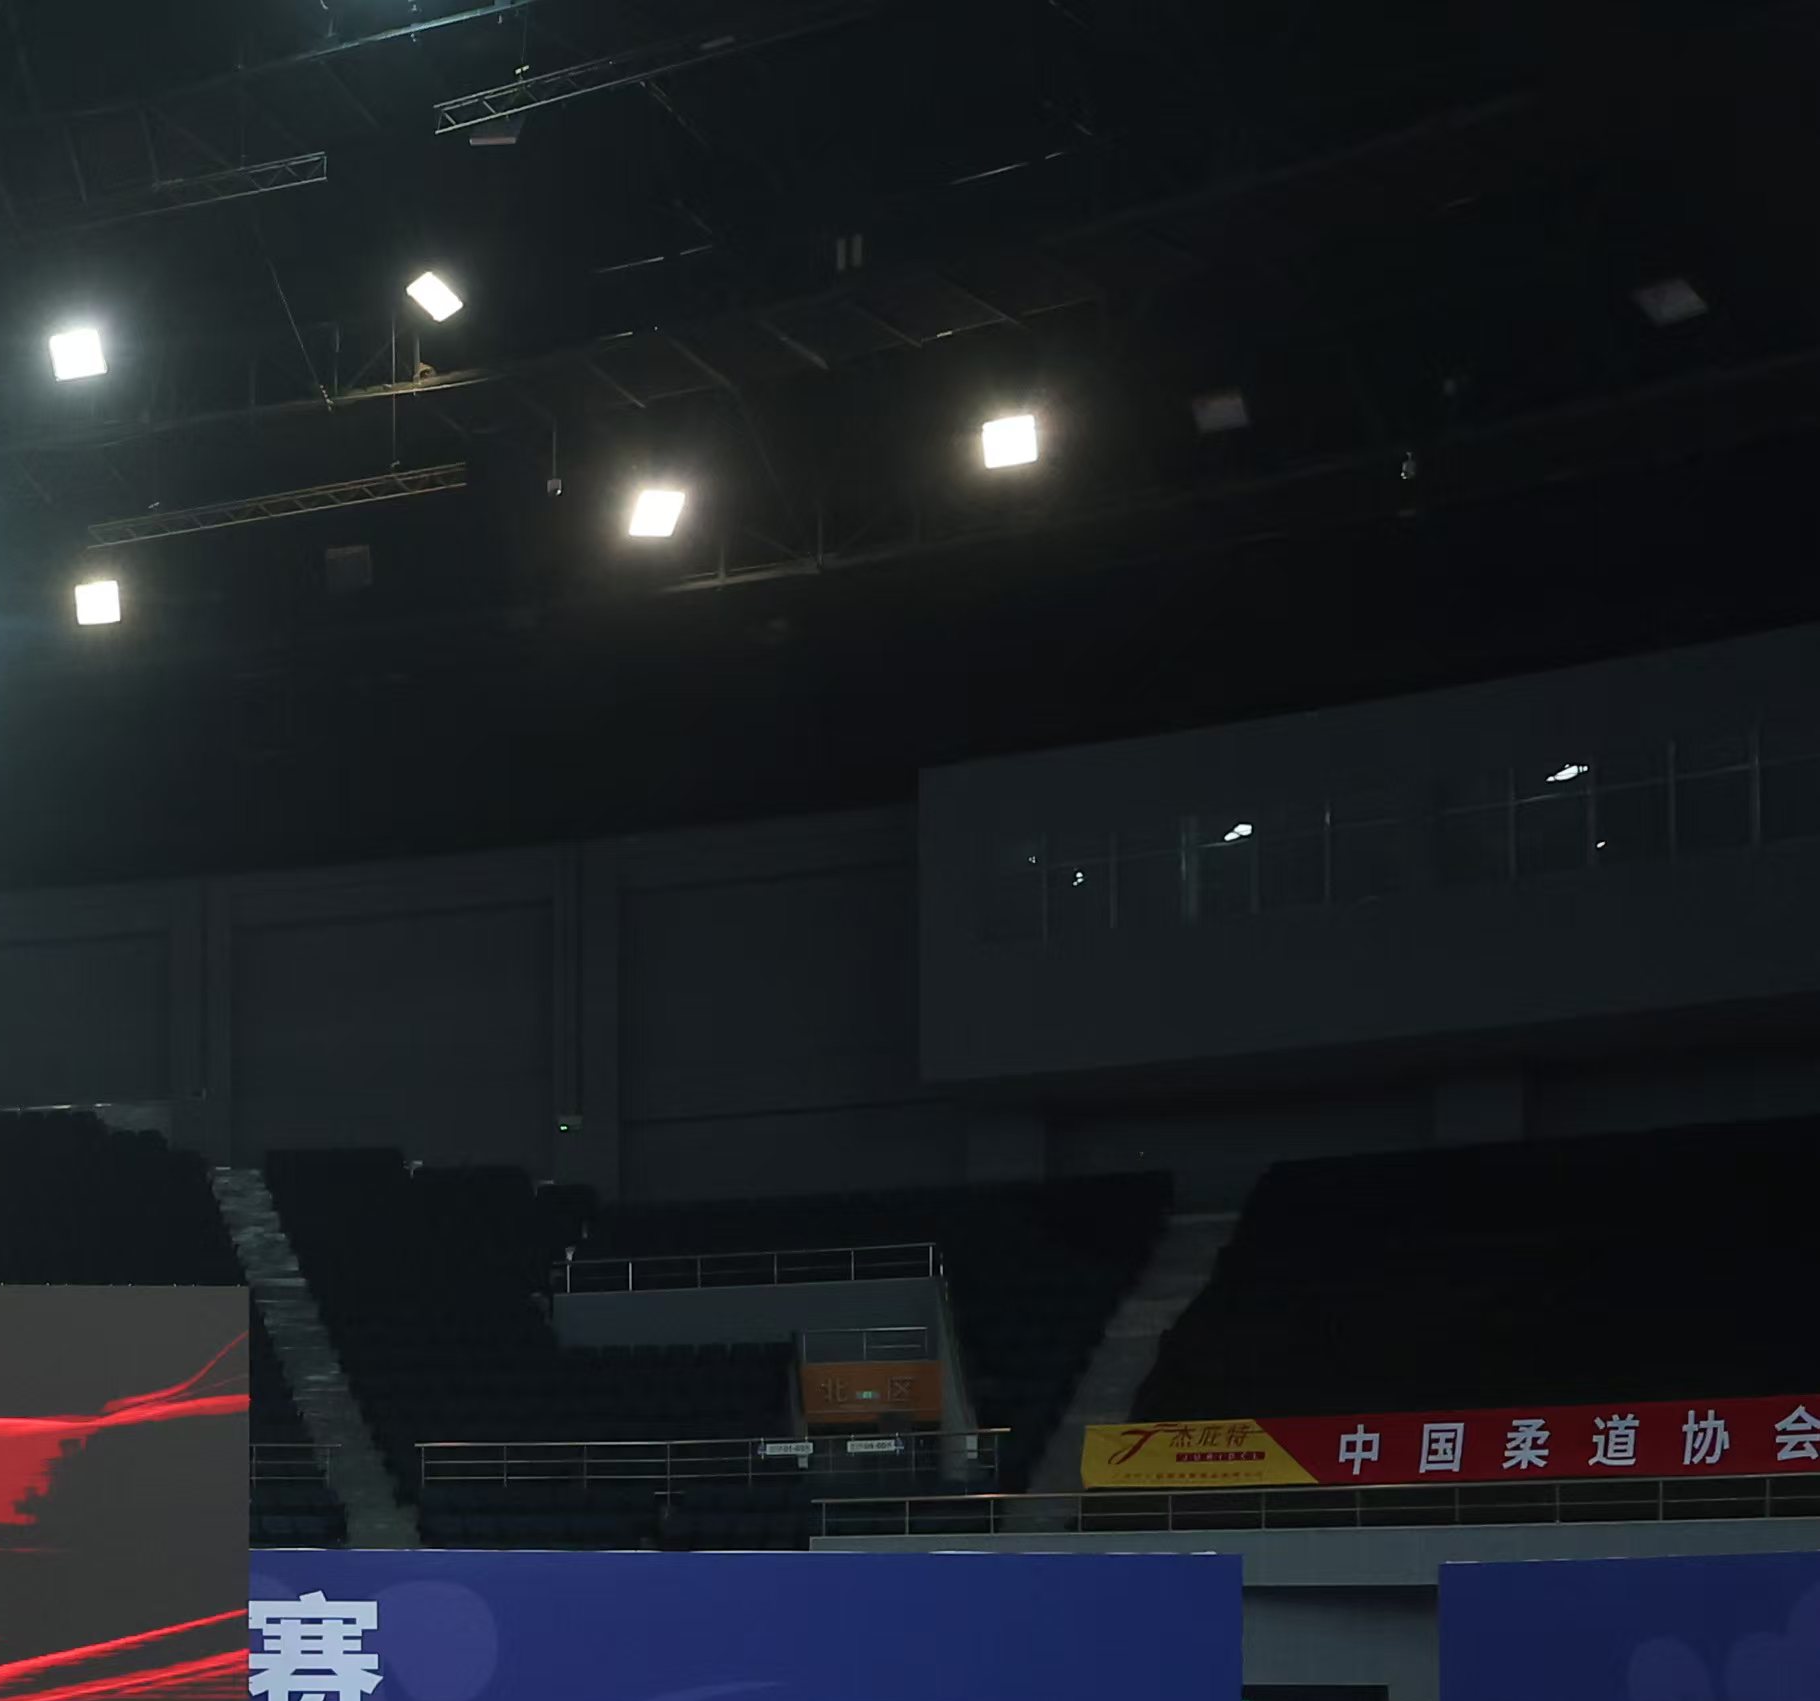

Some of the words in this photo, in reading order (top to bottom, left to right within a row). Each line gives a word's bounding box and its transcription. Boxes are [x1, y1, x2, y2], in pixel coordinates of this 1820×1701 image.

[1338, 1405, 1820, 1475] 中国柔道协会
